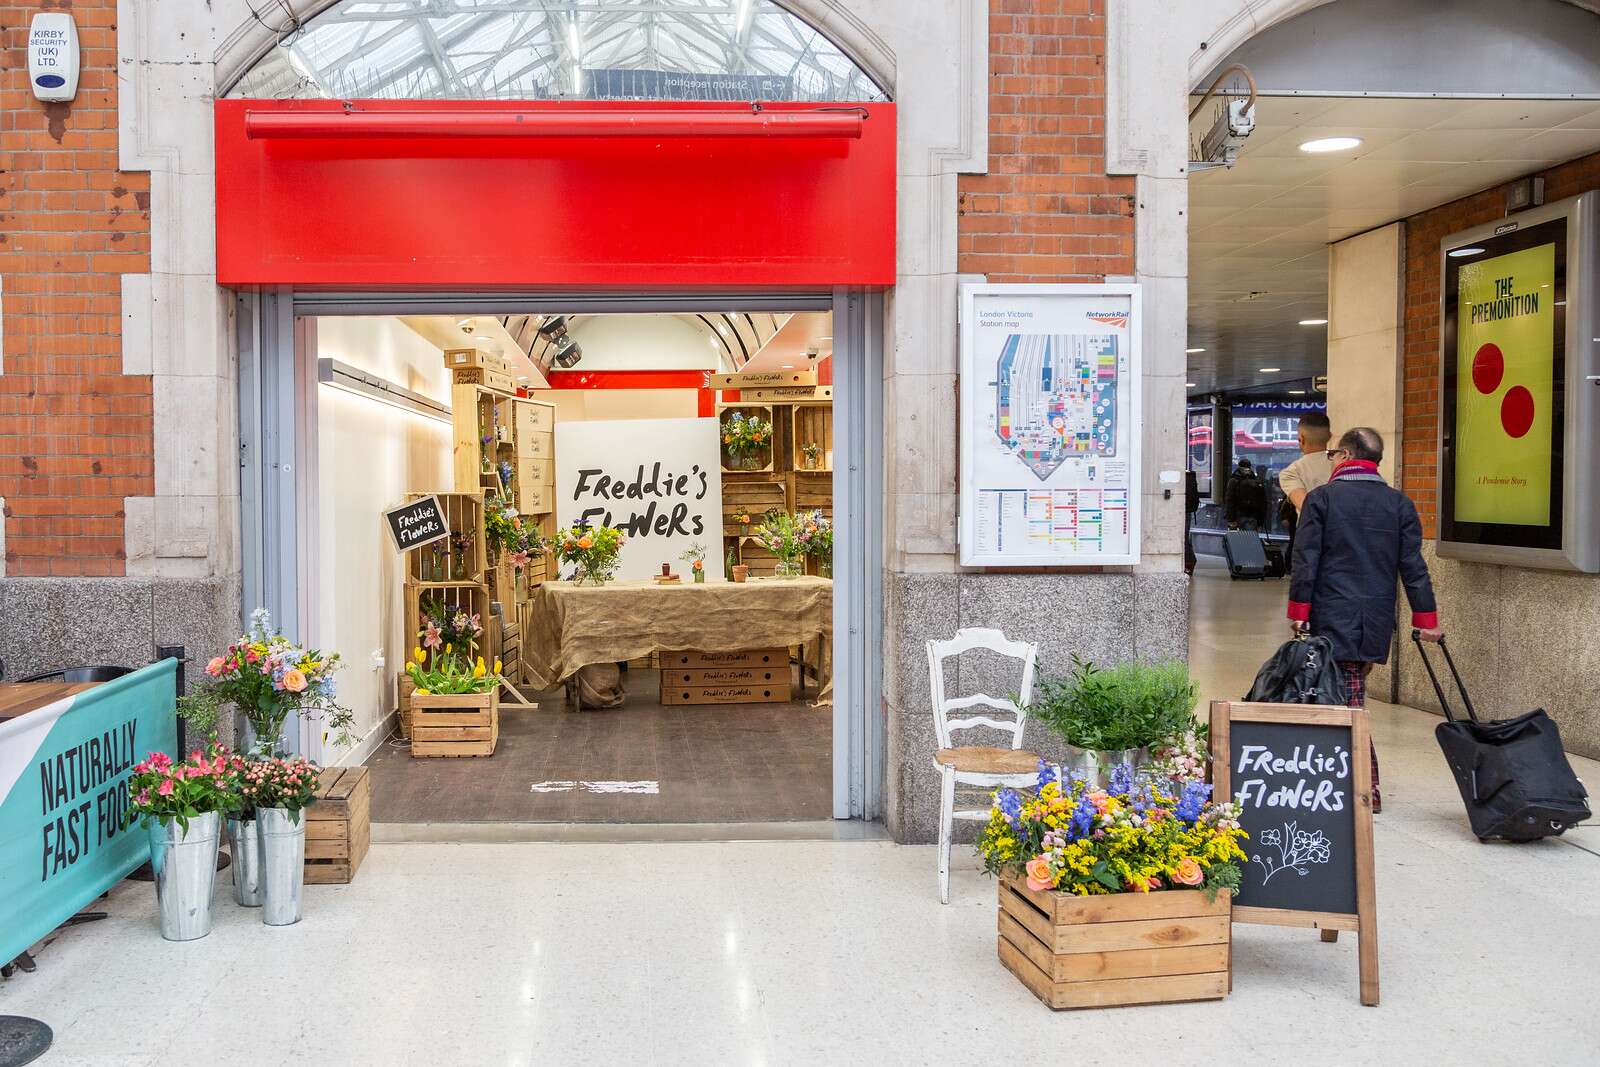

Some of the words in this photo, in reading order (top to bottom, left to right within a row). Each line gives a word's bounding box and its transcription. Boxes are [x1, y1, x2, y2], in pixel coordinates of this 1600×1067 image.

[34, 30, 64, 38] KIRBY
[38, 47, 58, 57] (UK)
[38, 57, 58, 66] LTD.
[1494, 276, 1514, 300] THE
[1471, 292, 1539, 325] PREMONITION
[1510, 476, 1528, 487] Story
[40, 718, 138, 816] NATURALLY
[42, 799, 91, 881] FAST
